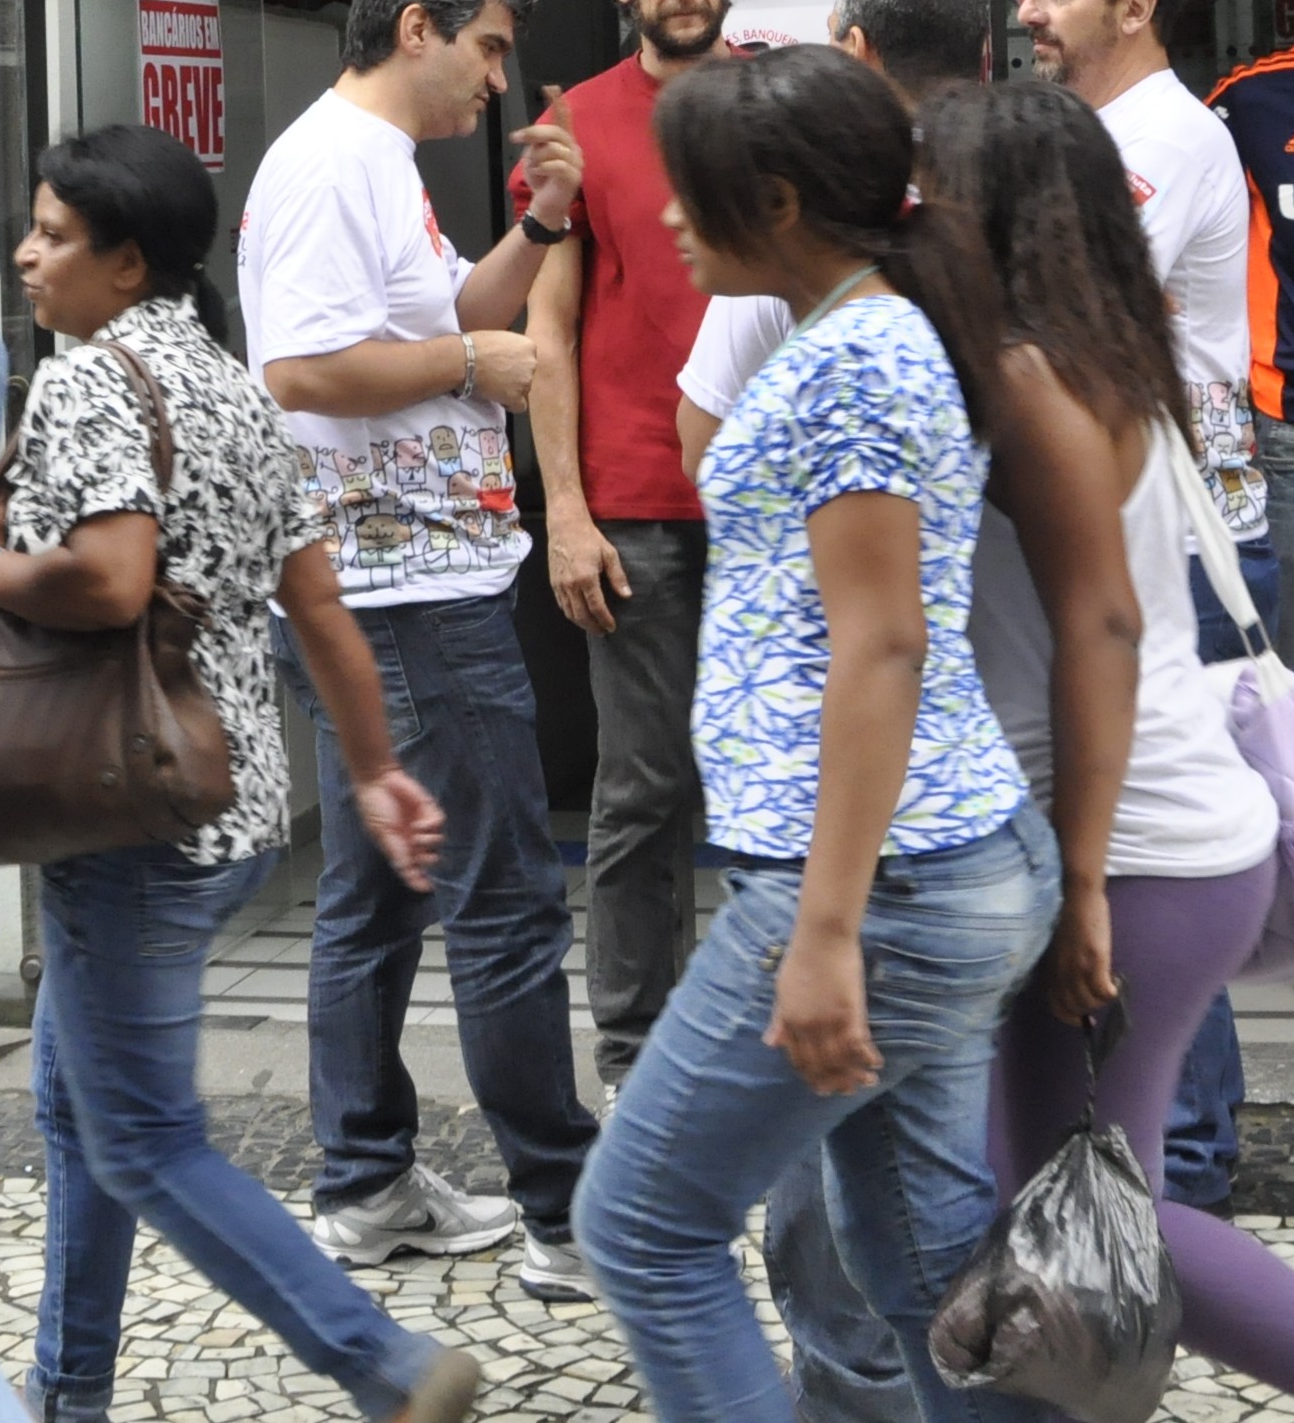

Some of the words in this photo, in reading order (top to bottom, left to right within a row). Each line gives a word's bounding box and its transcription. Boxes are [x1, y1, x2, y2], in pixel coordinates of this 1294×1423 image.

[140, 7, 203, 49] BANCÁRIOS
[205, 16, 219, 50] EM
[143, 62, 223, 154] GREVE
